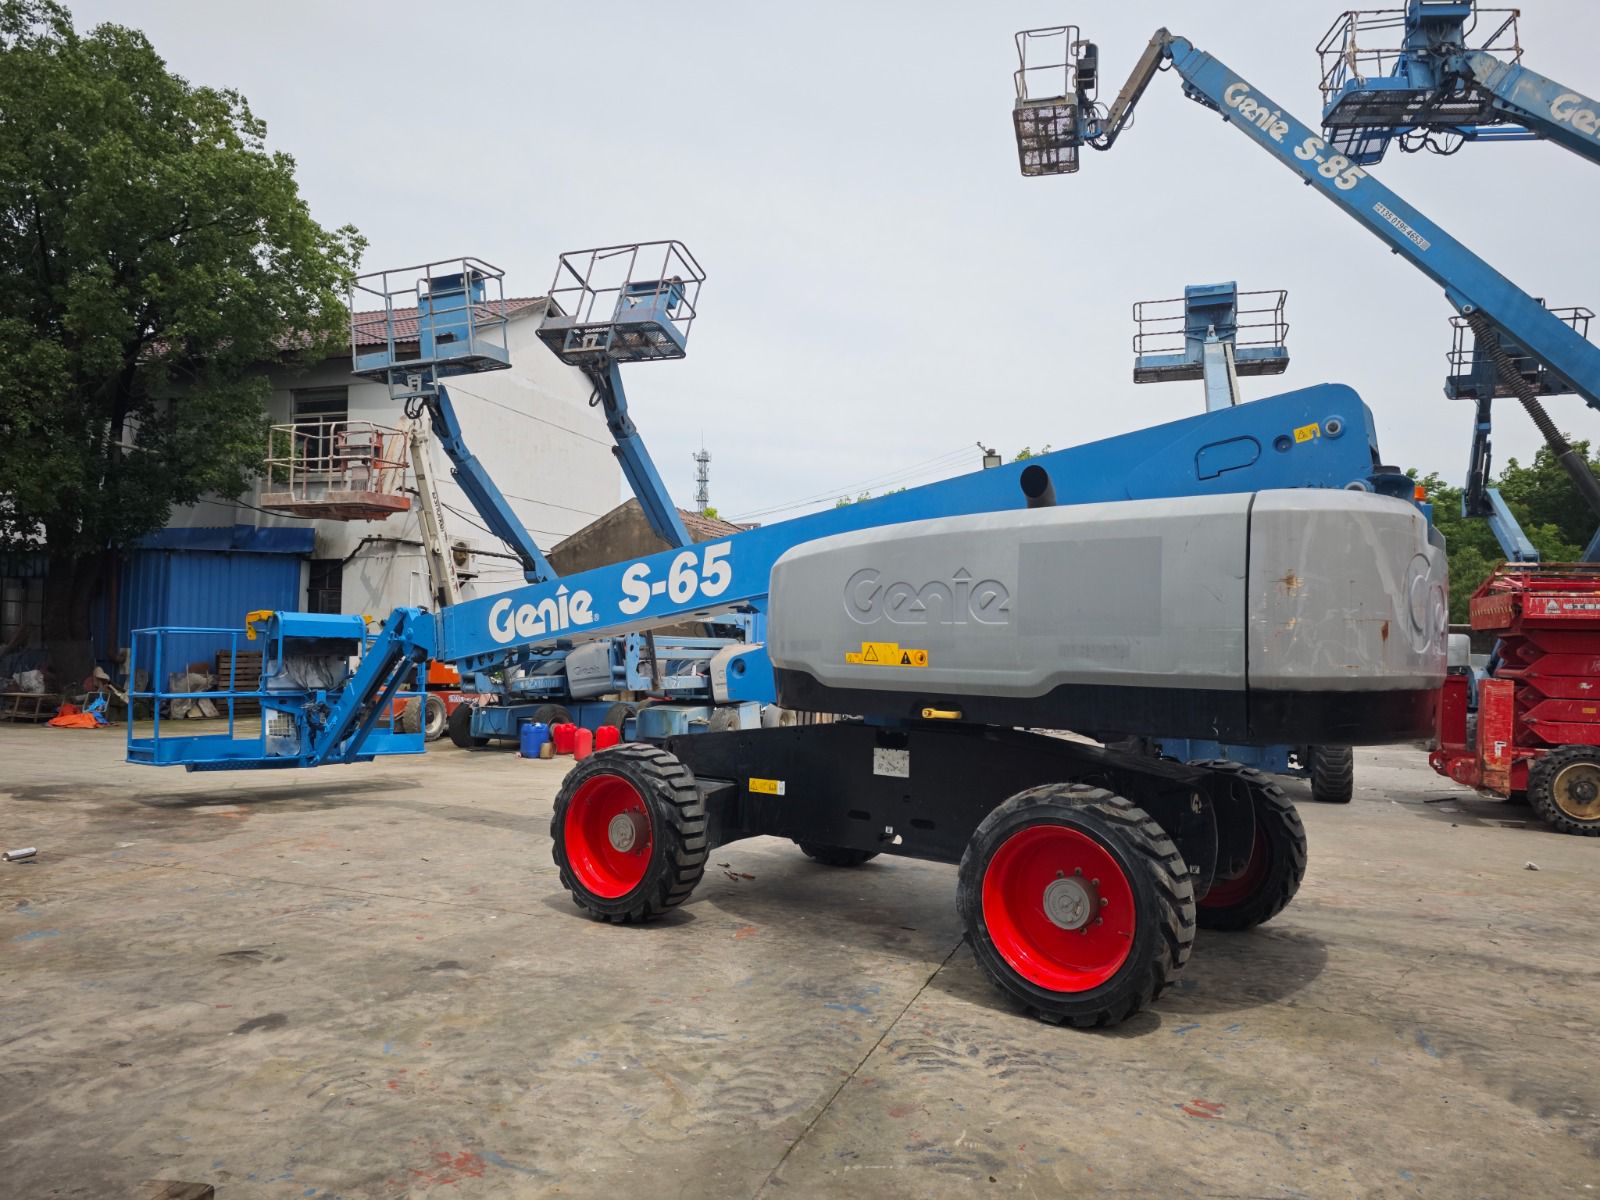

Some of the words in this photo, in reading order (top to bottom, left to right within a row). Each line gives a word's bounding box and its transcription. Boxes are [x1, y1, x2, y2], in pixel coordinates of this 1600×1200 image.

[1224, 82, 1289, 142] Genie
[1294, 137, 1367, 190] S-85
[1550, 93, 1600, 139] Ge
[488, 583, 593, 644] Genie
[618, 541, 732, 615] S-65
[843, 566, 1010, 625] Genie
